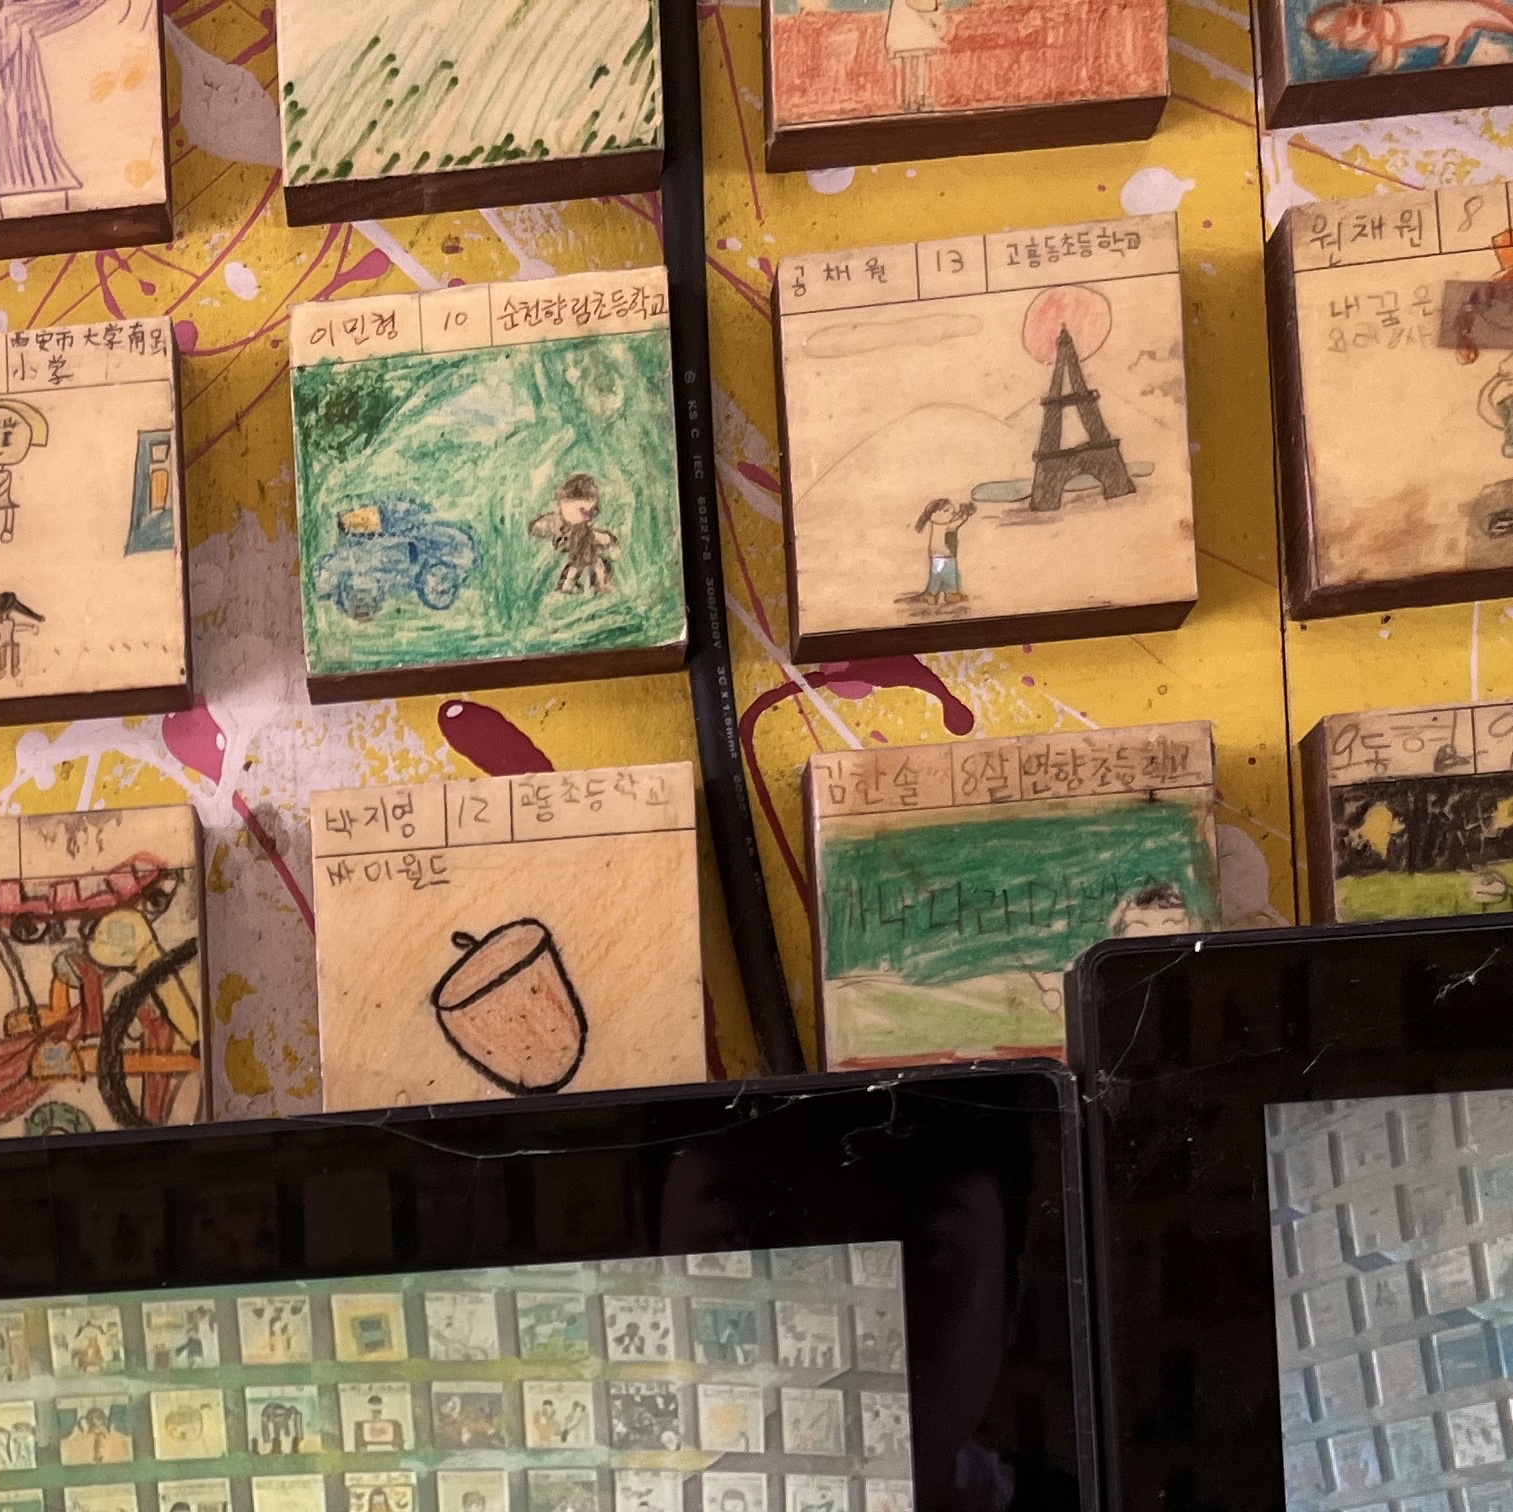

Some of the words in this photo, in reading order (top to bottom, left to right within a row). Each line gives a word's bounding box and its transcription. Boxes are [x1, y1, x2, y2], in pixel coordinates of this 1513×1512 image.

[1457, 195, 1484, 233] 8
[935, 249, 964, 274] 13
[442, 311, 468, 332] 10
[458, 796, 492, 829] 12
